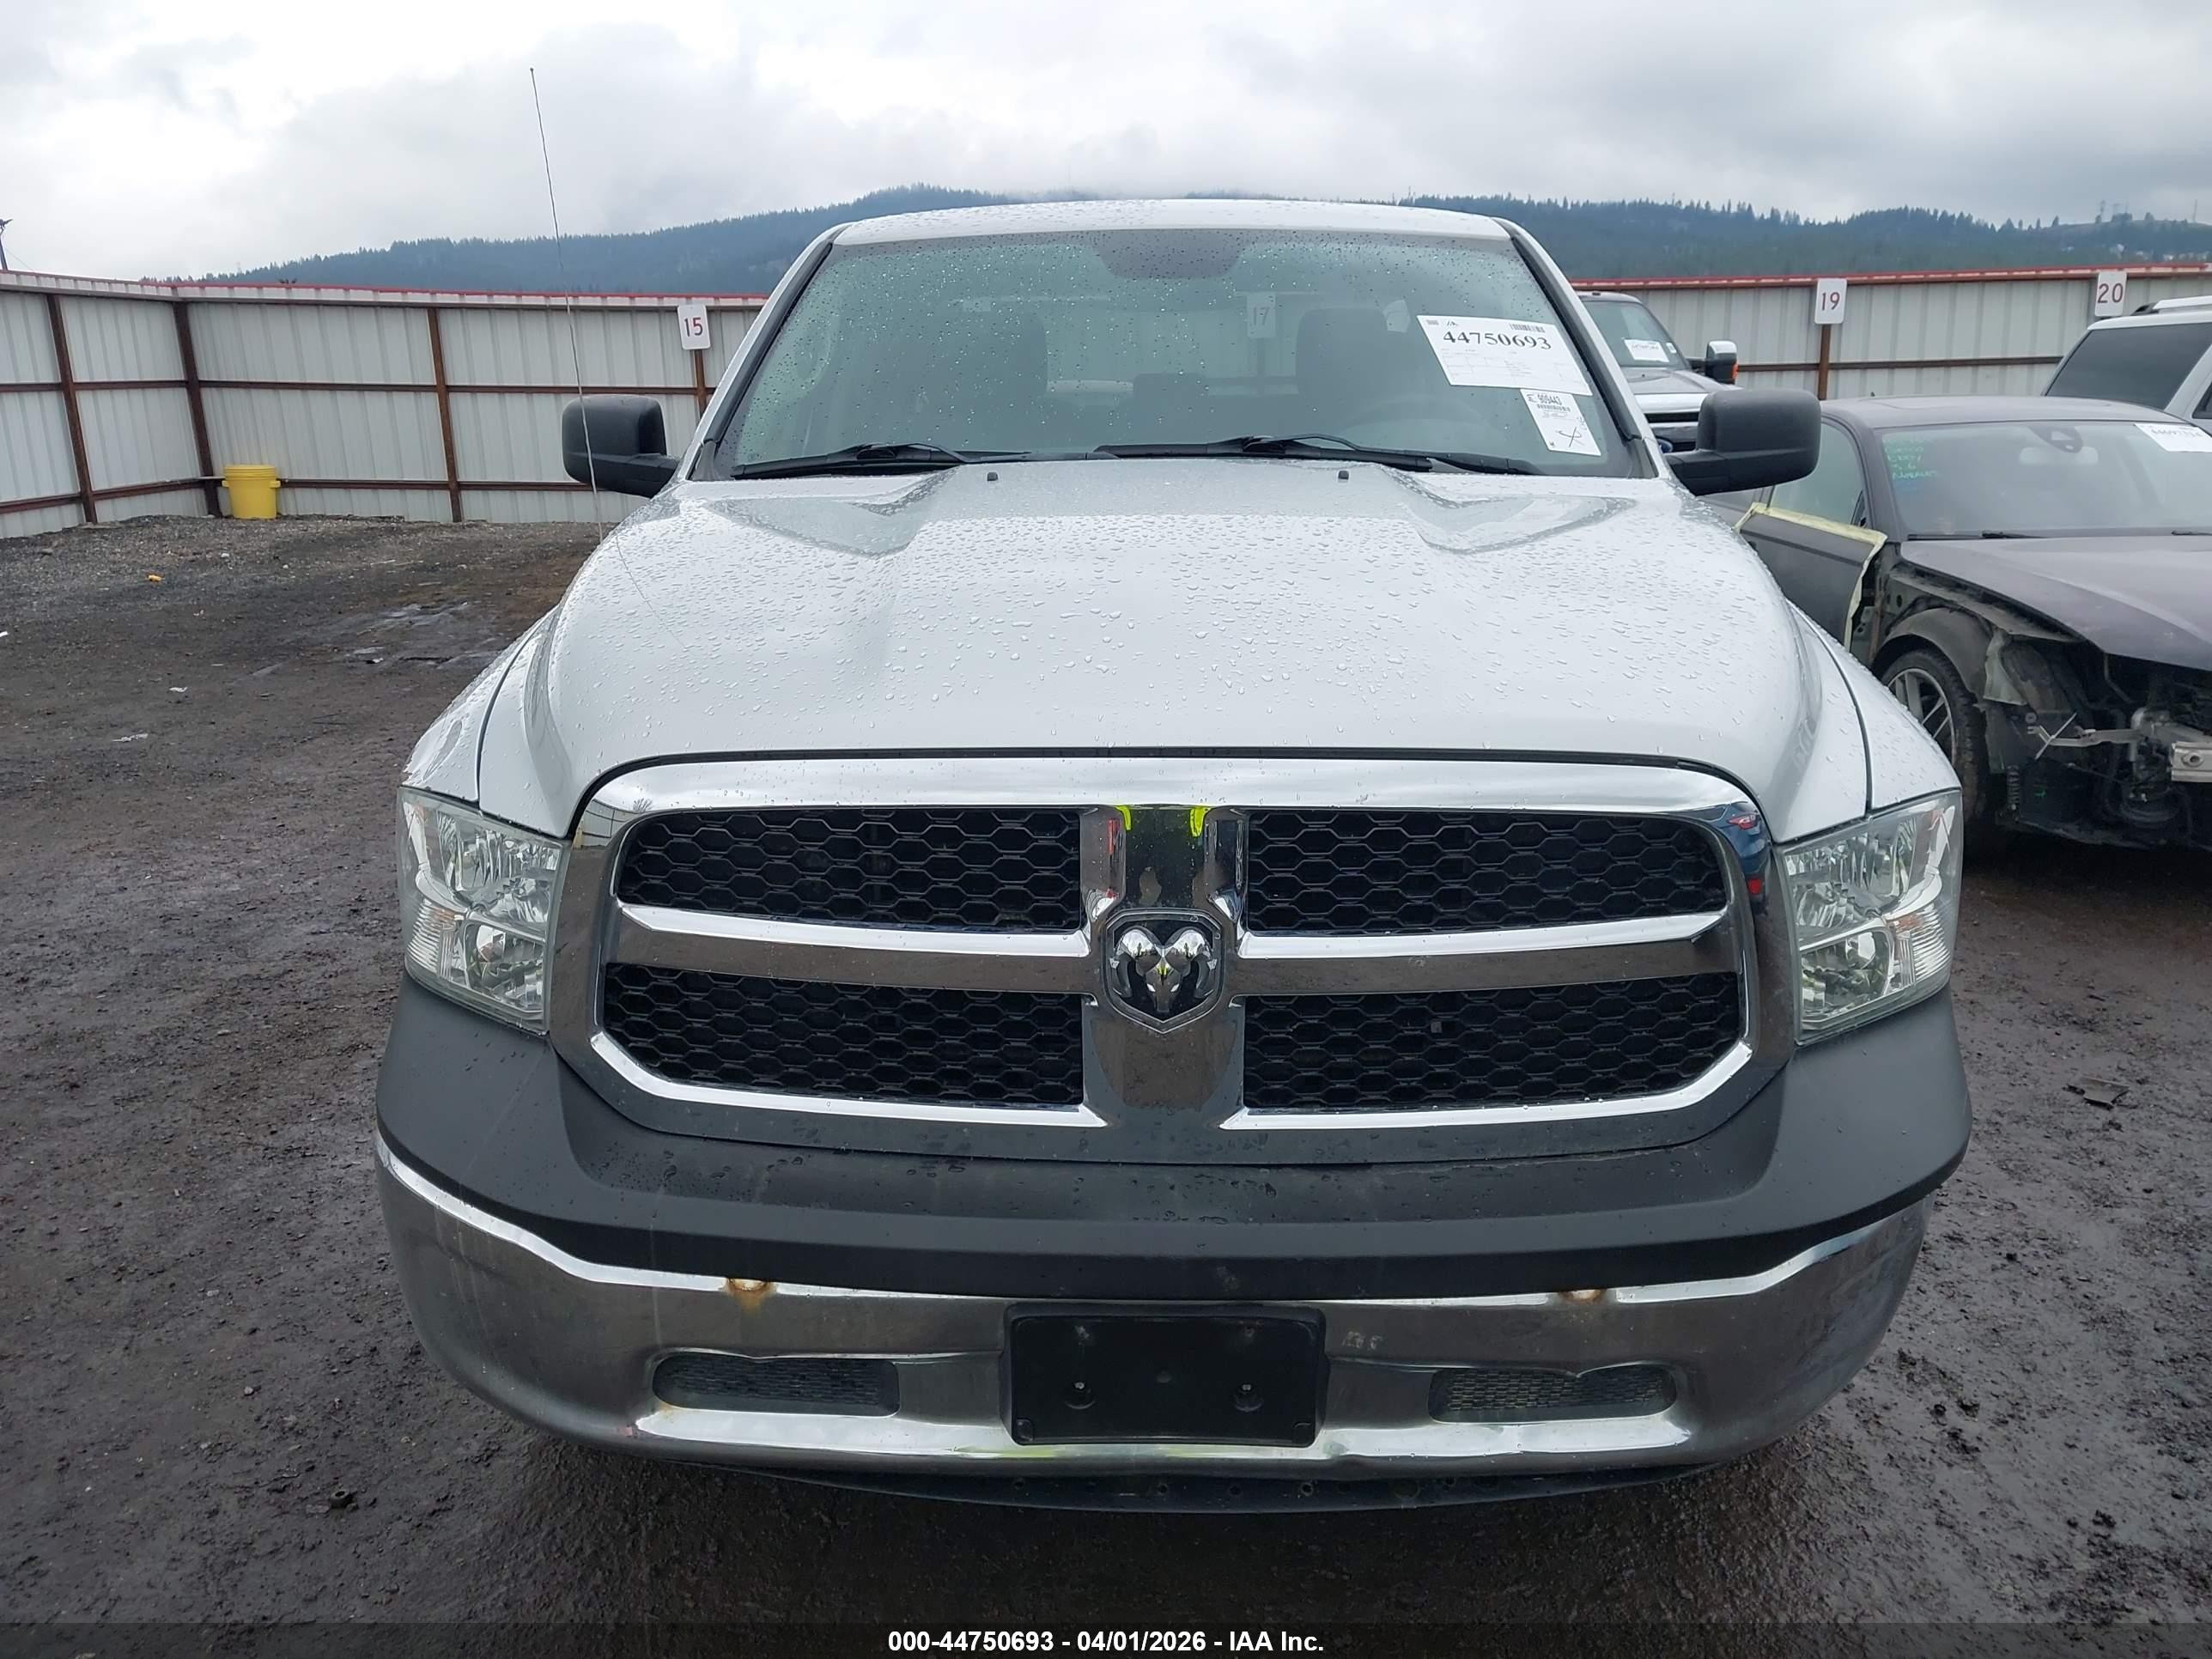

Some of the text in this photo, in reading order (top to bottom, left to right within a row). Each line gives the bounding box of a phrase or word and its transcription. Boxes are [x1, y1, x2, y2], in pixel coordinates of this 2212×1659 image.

[1820, 292, 1840, 312] 19
[2097, 283, 2124, 303] 20
[1254, 307, 1269, 325] 17
[684, 317, 703, 337] 15
[1443, 331, 1552, 349] 44750693
